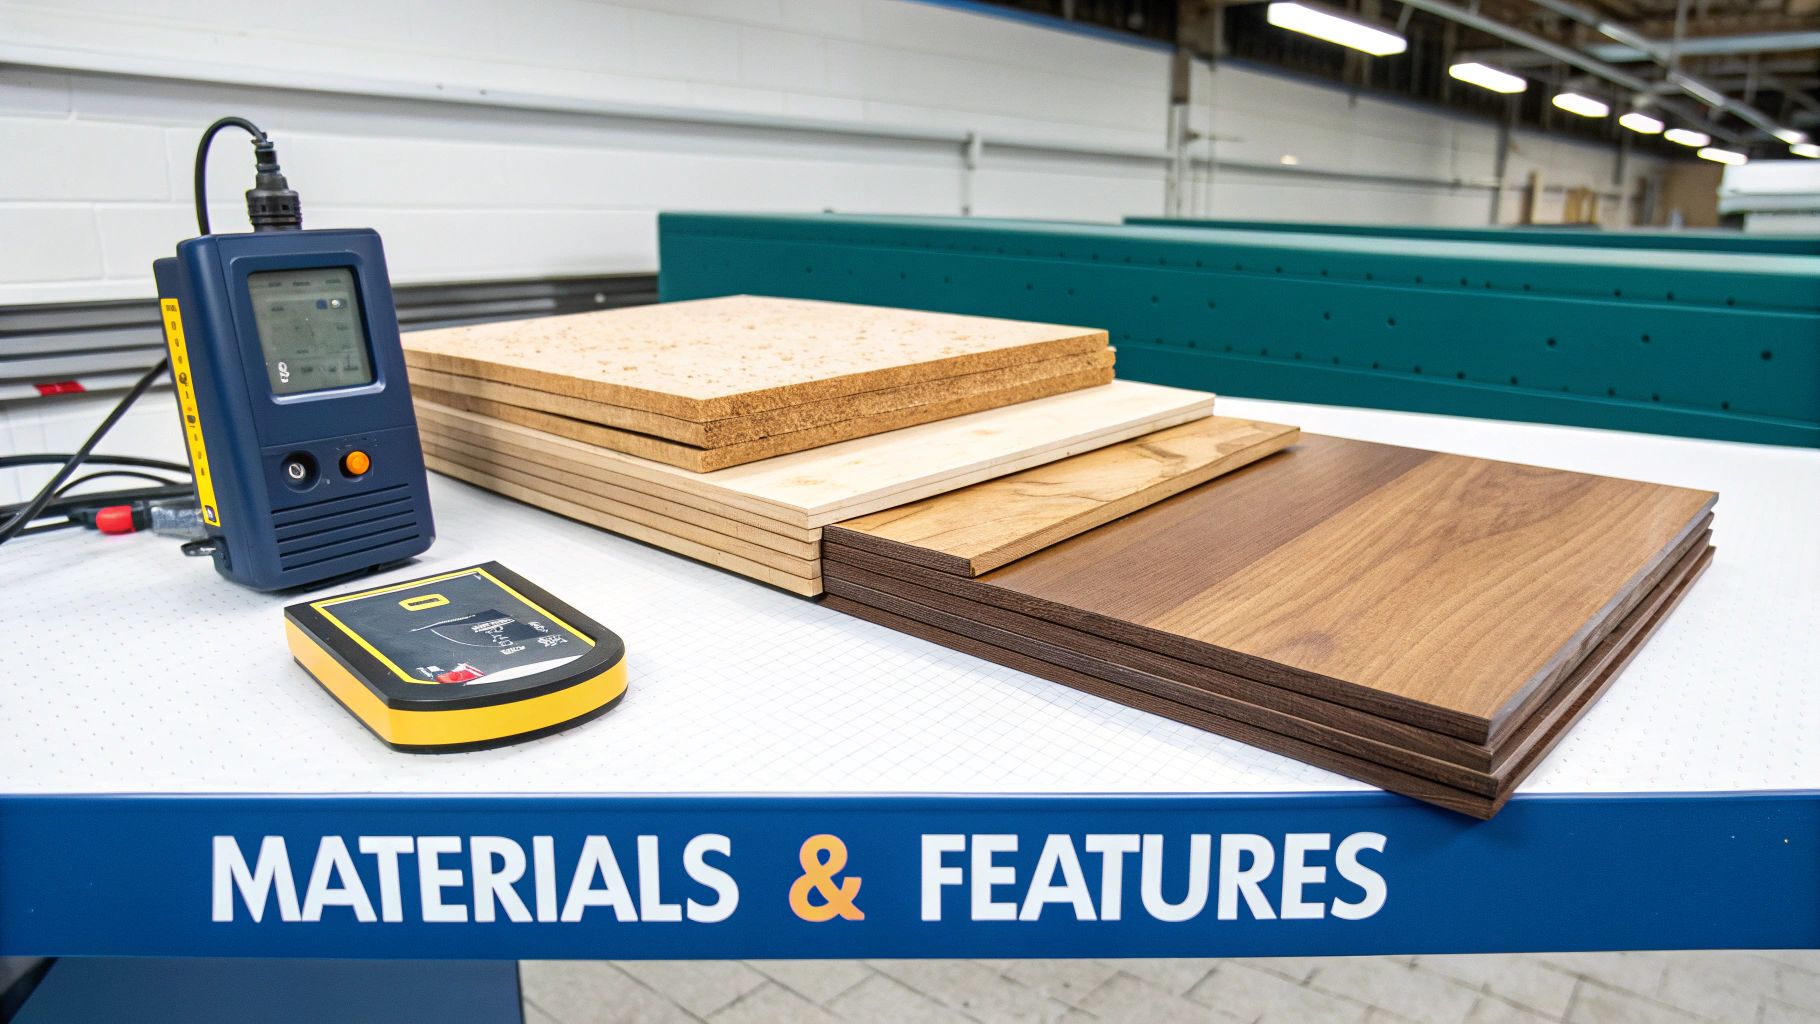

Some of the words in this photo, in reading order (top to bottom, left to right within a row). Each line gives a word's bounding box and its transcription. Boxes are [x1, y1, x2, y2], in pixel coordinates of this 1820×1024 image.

[212, 833, 740, 924] MATERIALS
[788, 833, 866, 923] &
[920, 832, 1389, 922] FEATURES
